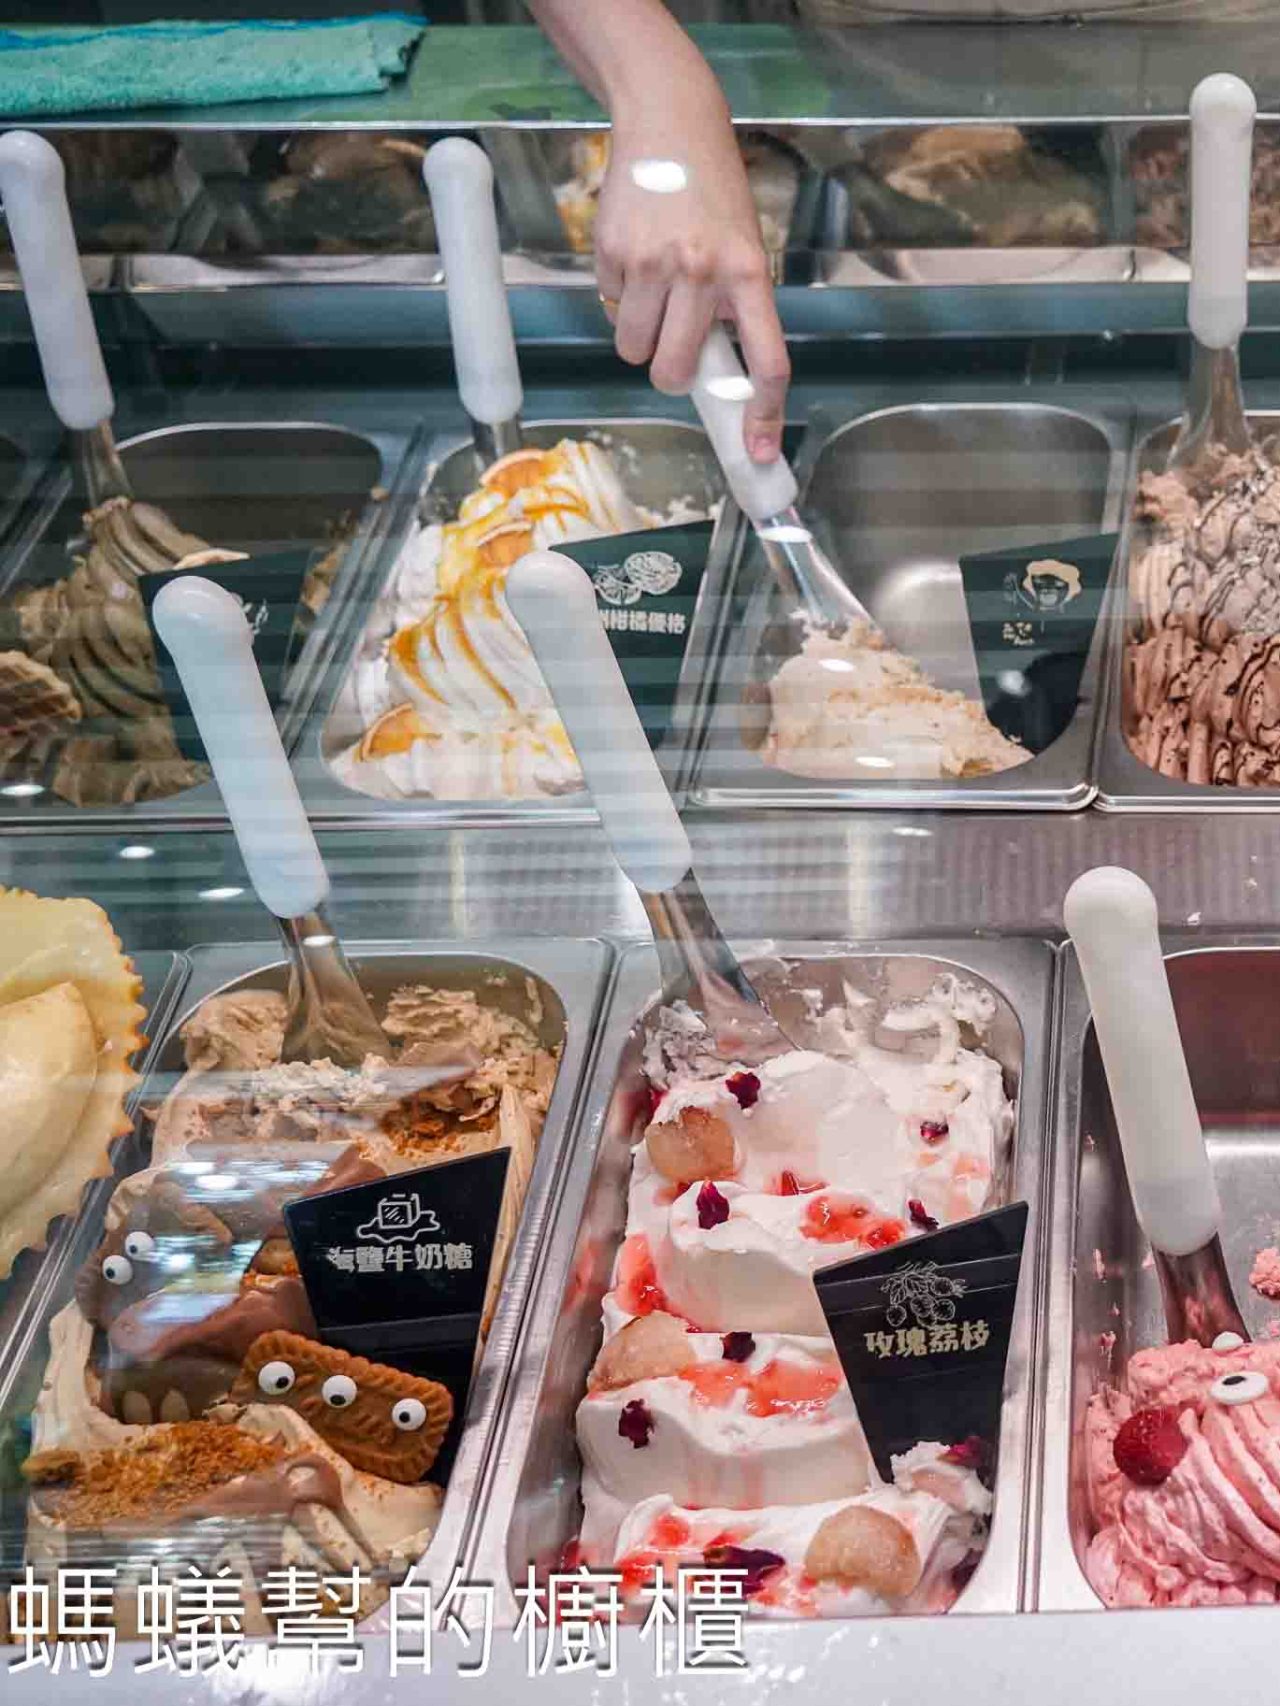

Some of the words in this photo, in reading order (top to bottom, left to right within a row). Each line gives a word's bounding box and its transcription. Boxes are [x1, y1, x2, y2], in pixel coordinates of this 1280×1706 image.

[326, 1242, 474, 1273] 海鹽牛奶糖
[863, 1319, 990, 1359] 玫瑰荔枝
